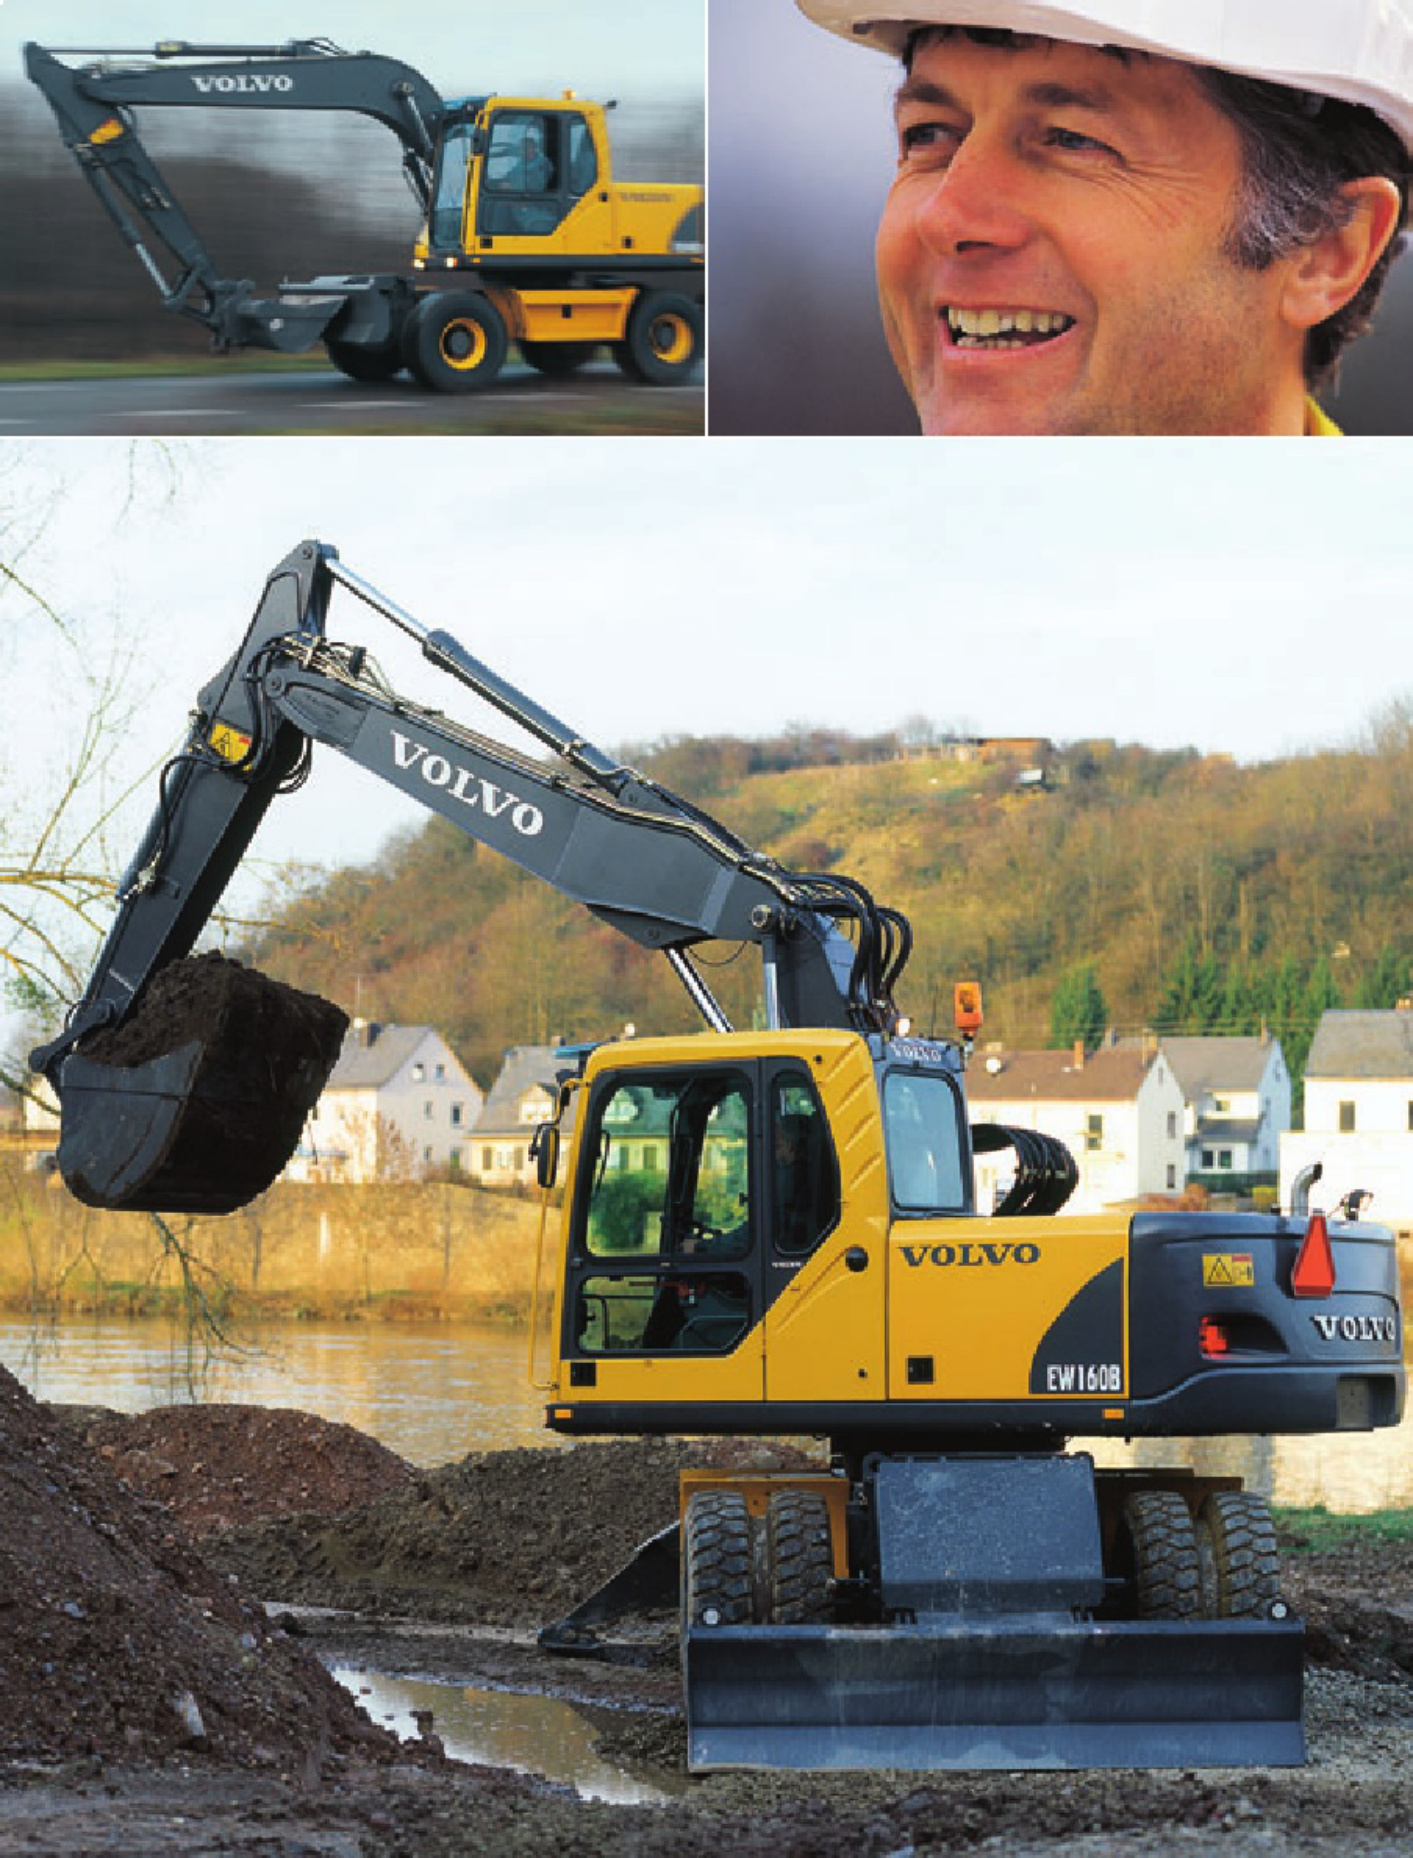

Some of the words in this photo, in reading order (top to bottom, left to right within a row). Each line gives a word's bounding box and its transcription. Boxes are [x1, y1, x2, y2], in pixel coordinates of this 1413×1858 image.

[191, 75, 294, 92] VOLVO
[390, 730, 544, 836] VOLVO
[897, 1243, 1042, 1267] VOLVO
[1310, 1314, 1396, 1342] VOLVO
[1046, 1363, 1121, 1392] EW160B
